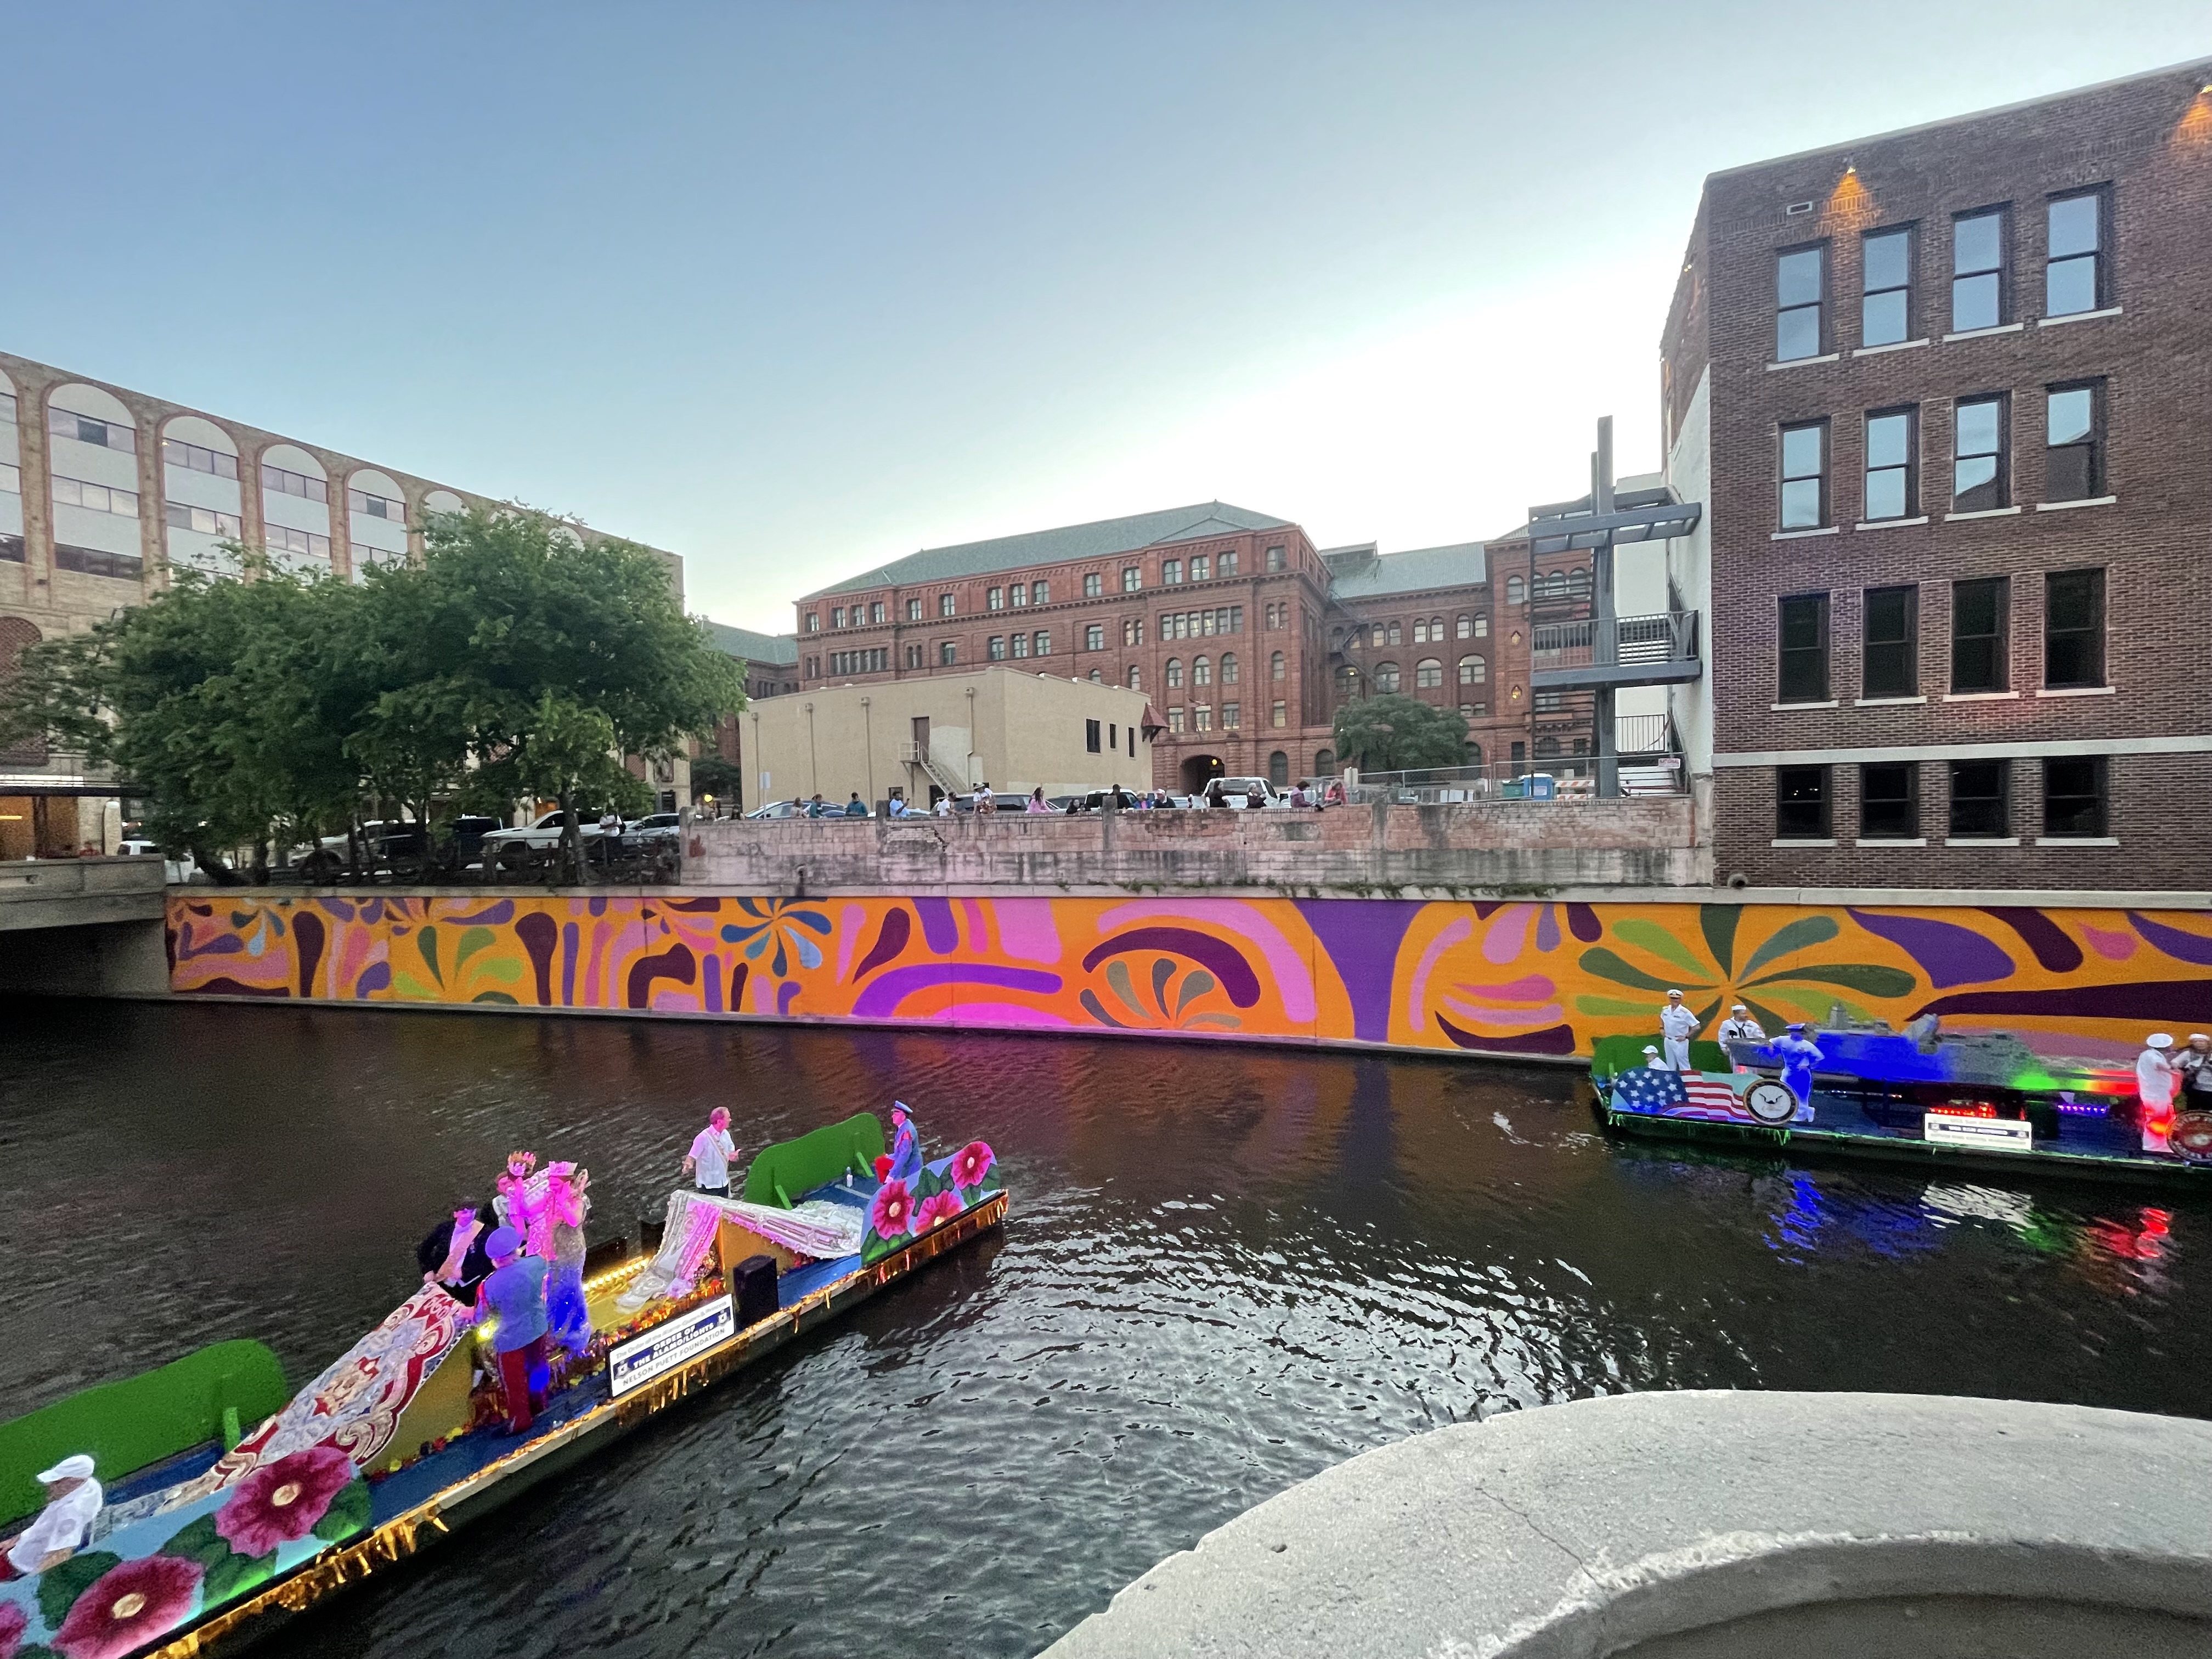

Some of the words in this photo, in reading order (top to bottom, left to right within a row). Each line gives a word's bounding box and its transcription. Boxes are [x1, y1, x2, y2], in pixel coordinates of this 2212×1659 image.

[623, 1365, 653, 1386] NELSON
[655, 1352, 678, 1368] PUETT
[678, 1328, 725, 1356] FOUNDATION
[633, 1355, 650, 1368] THE
[652, 1323, 714, 1359] ALAMO/LIGHTS
[653, 1333, 682, 1351] ORDER
[684, 1325, 695, 1335] OF
